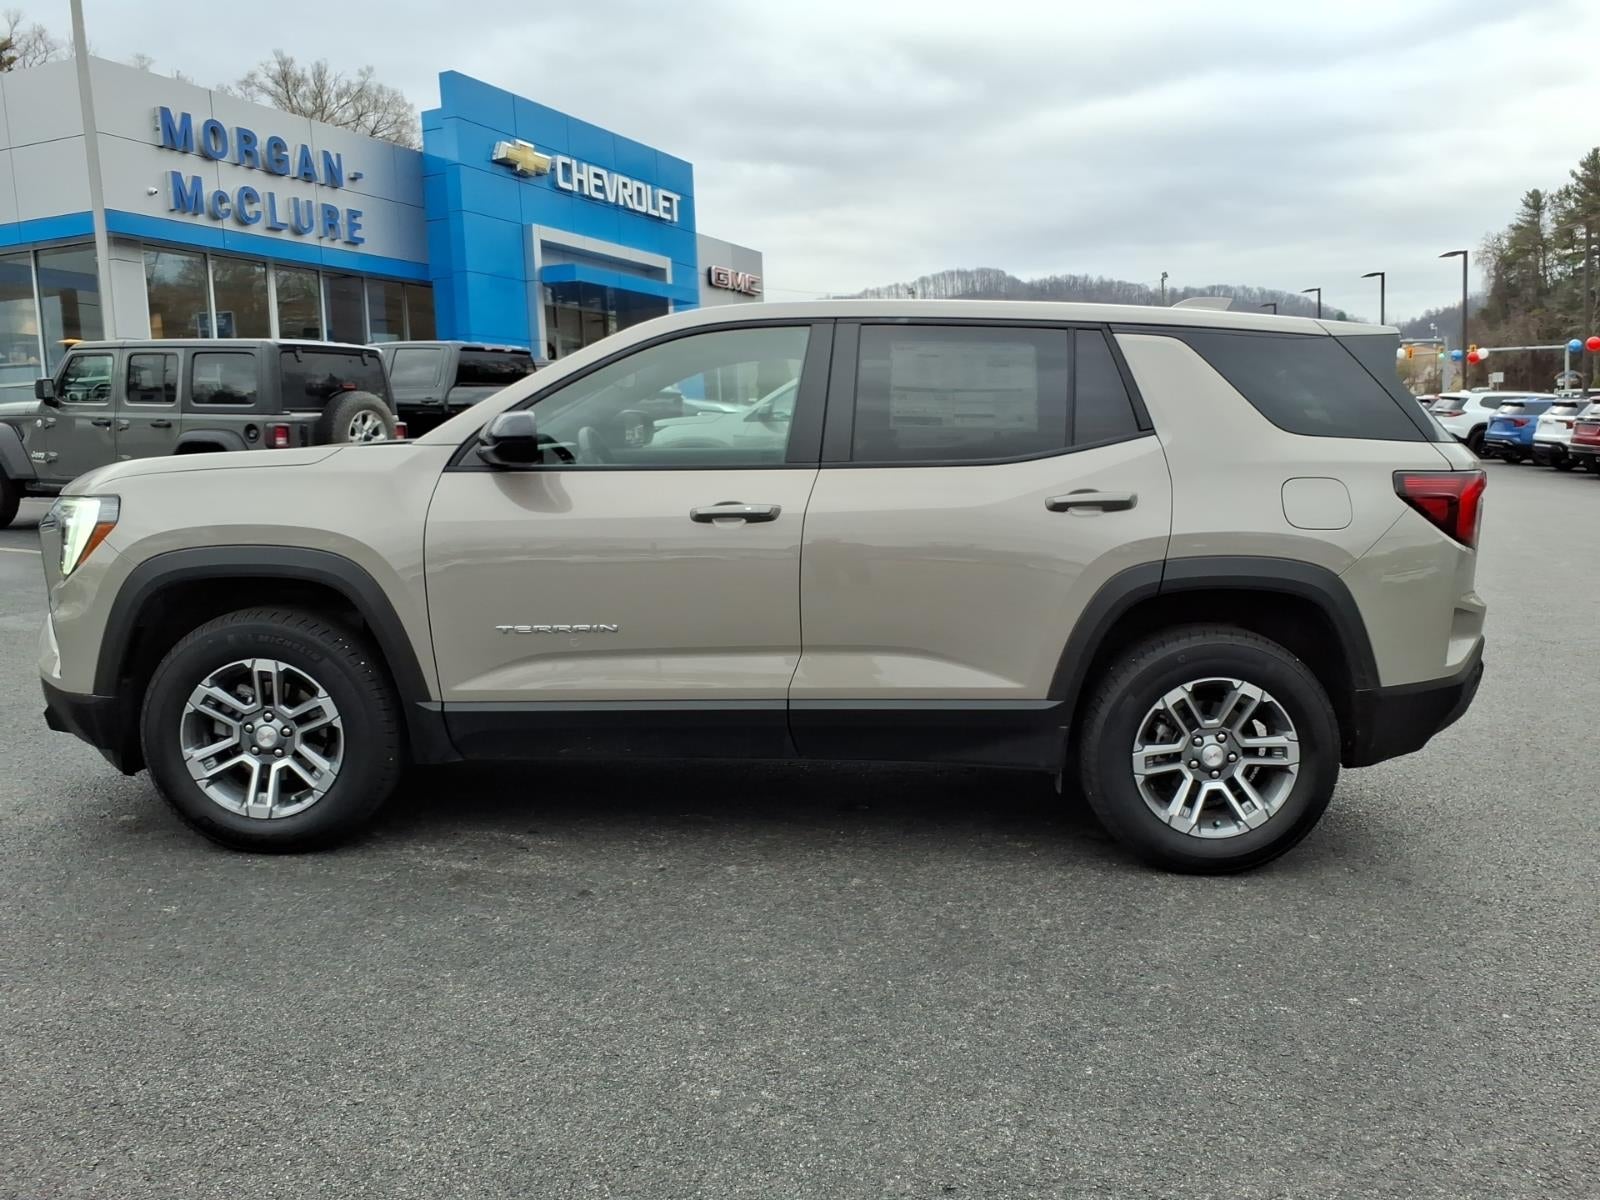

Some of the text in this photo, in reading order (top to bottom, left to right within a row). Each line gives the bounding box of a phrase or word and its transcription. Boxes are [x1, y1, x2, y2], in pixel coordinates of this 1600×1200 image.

[166, 171, 365, 244] McCLURE
[553, 155, 681, 222] CHEVROLET
[708, 265, 762, 296] GMC
[495, 624, 619, 634] TERRAIN
